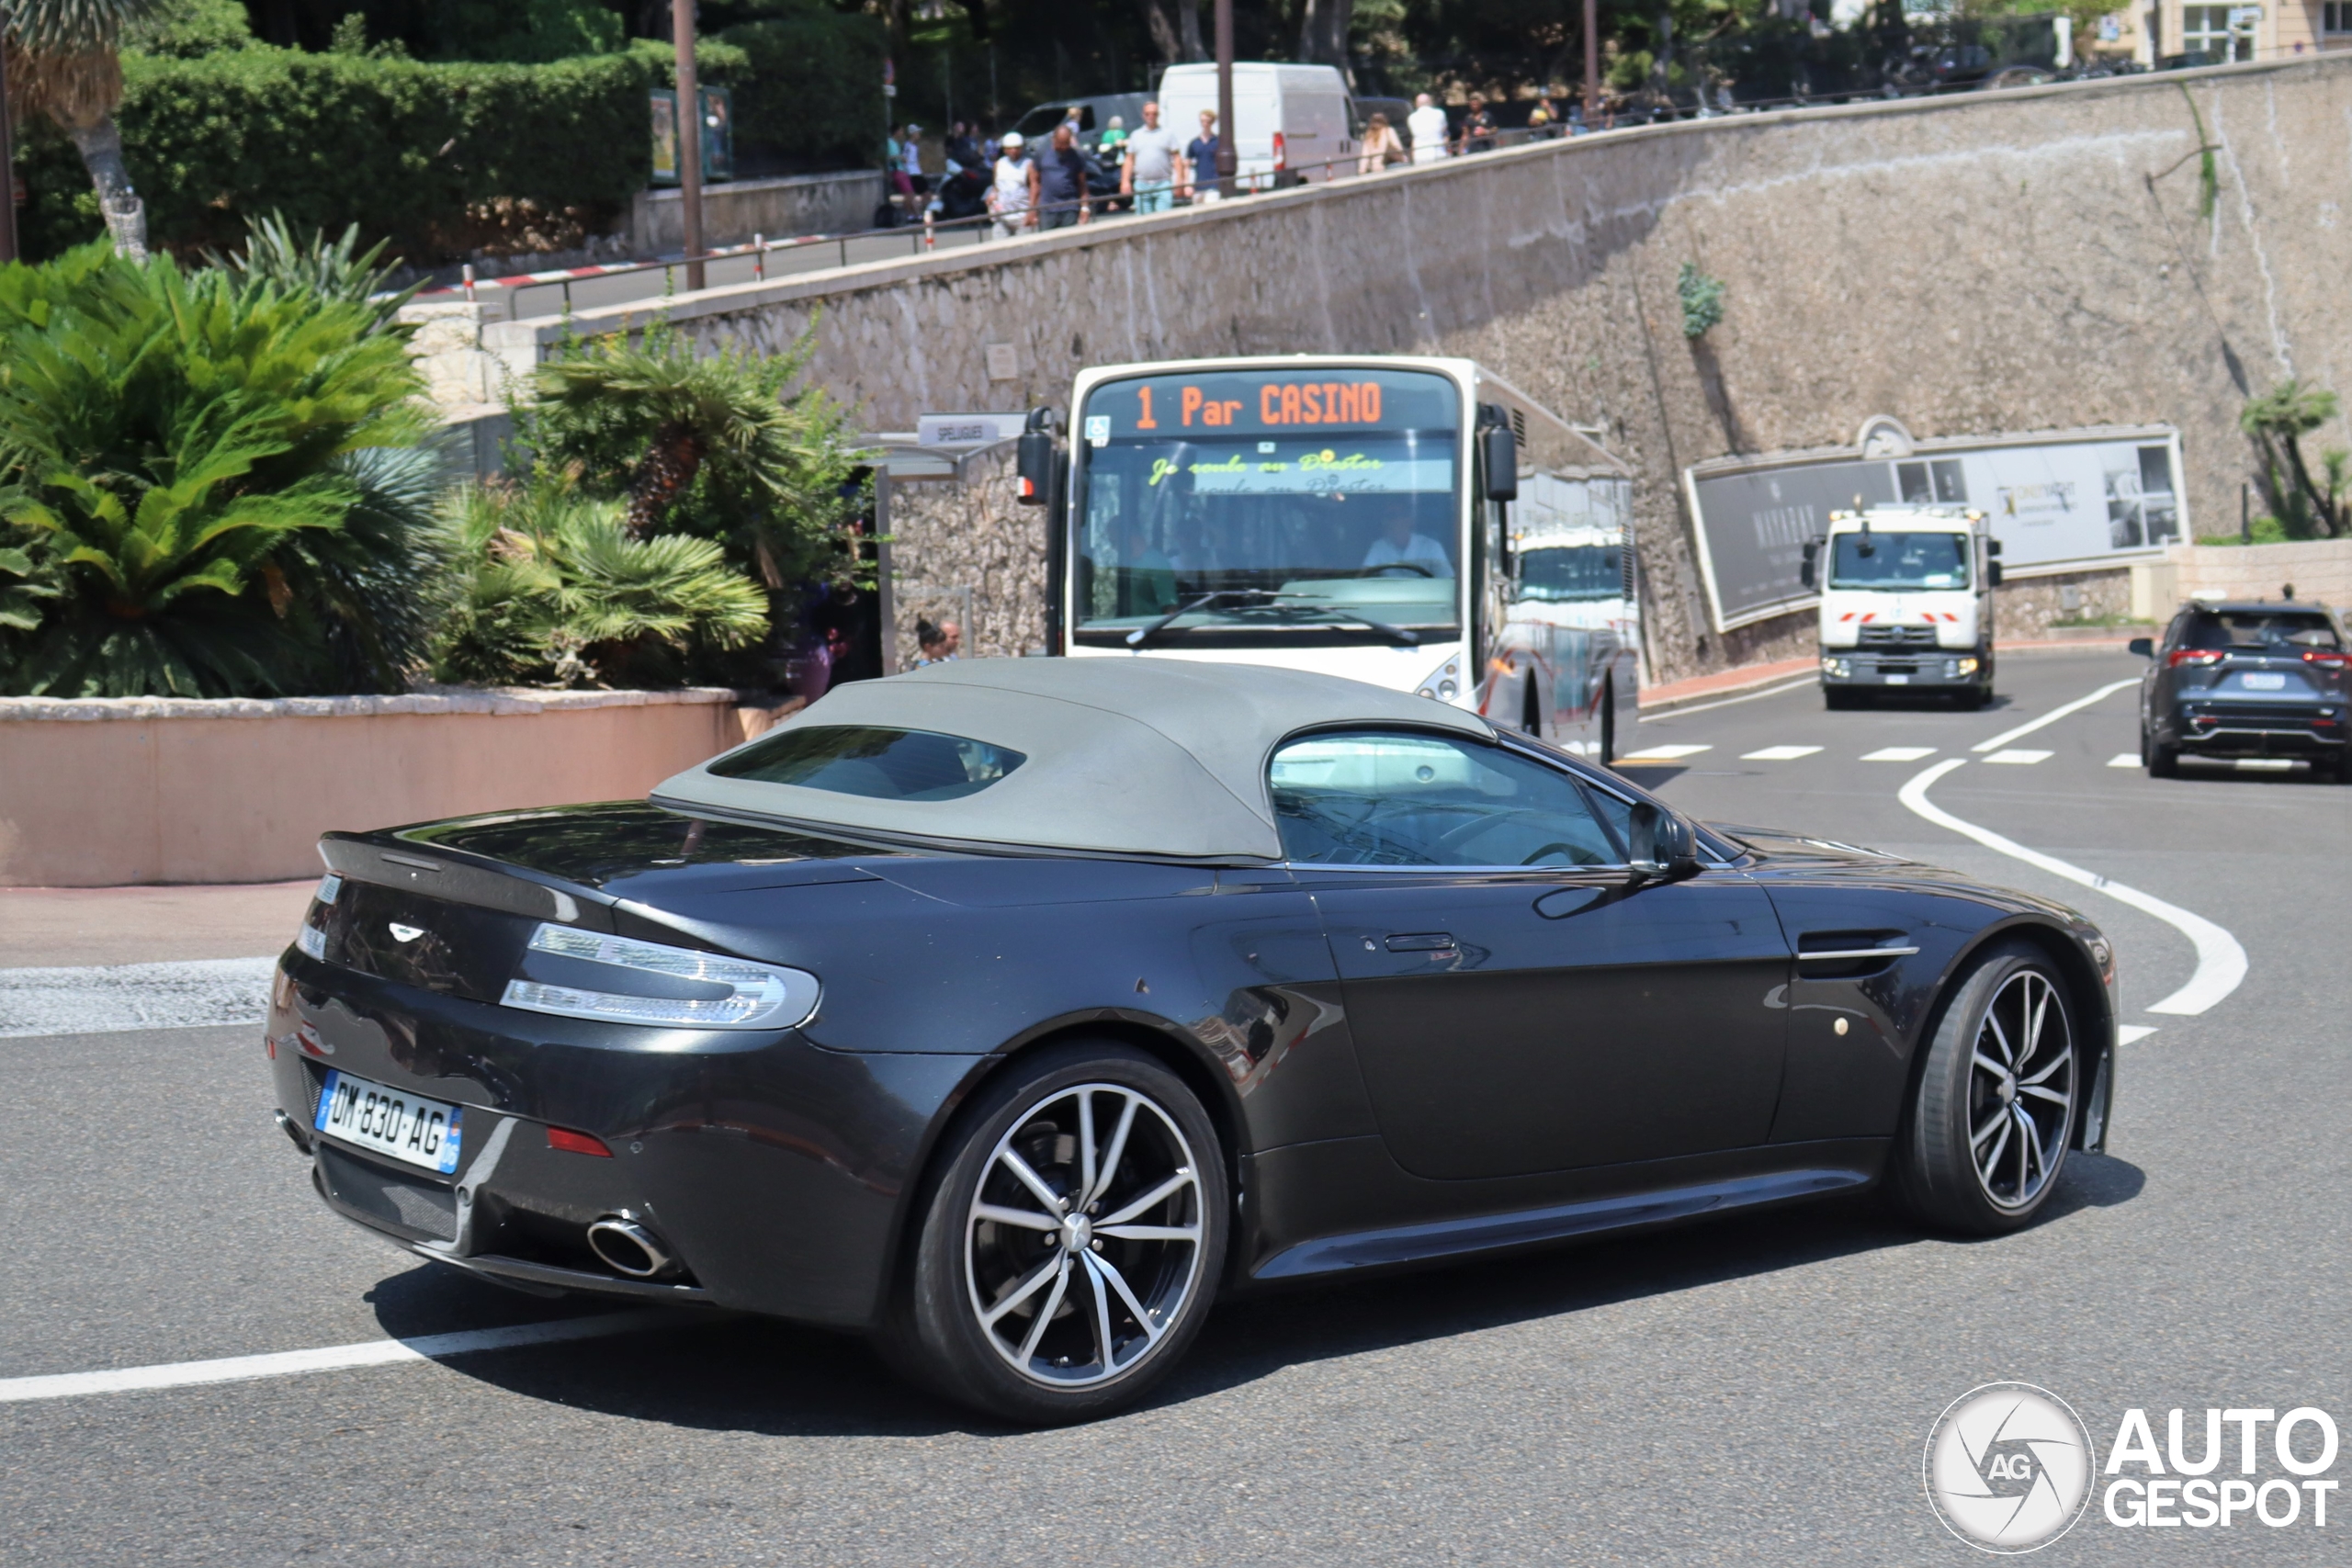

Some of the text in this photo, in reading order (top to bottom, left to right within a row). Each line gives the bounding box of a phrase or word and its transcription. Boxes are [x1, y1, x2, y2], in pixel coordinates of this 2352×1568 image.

[1136, 382, 1382, 429] 1 Par CASINO
[1148, 458, 1179, 486] Je
[441, 1142, 459, 1167] 06
